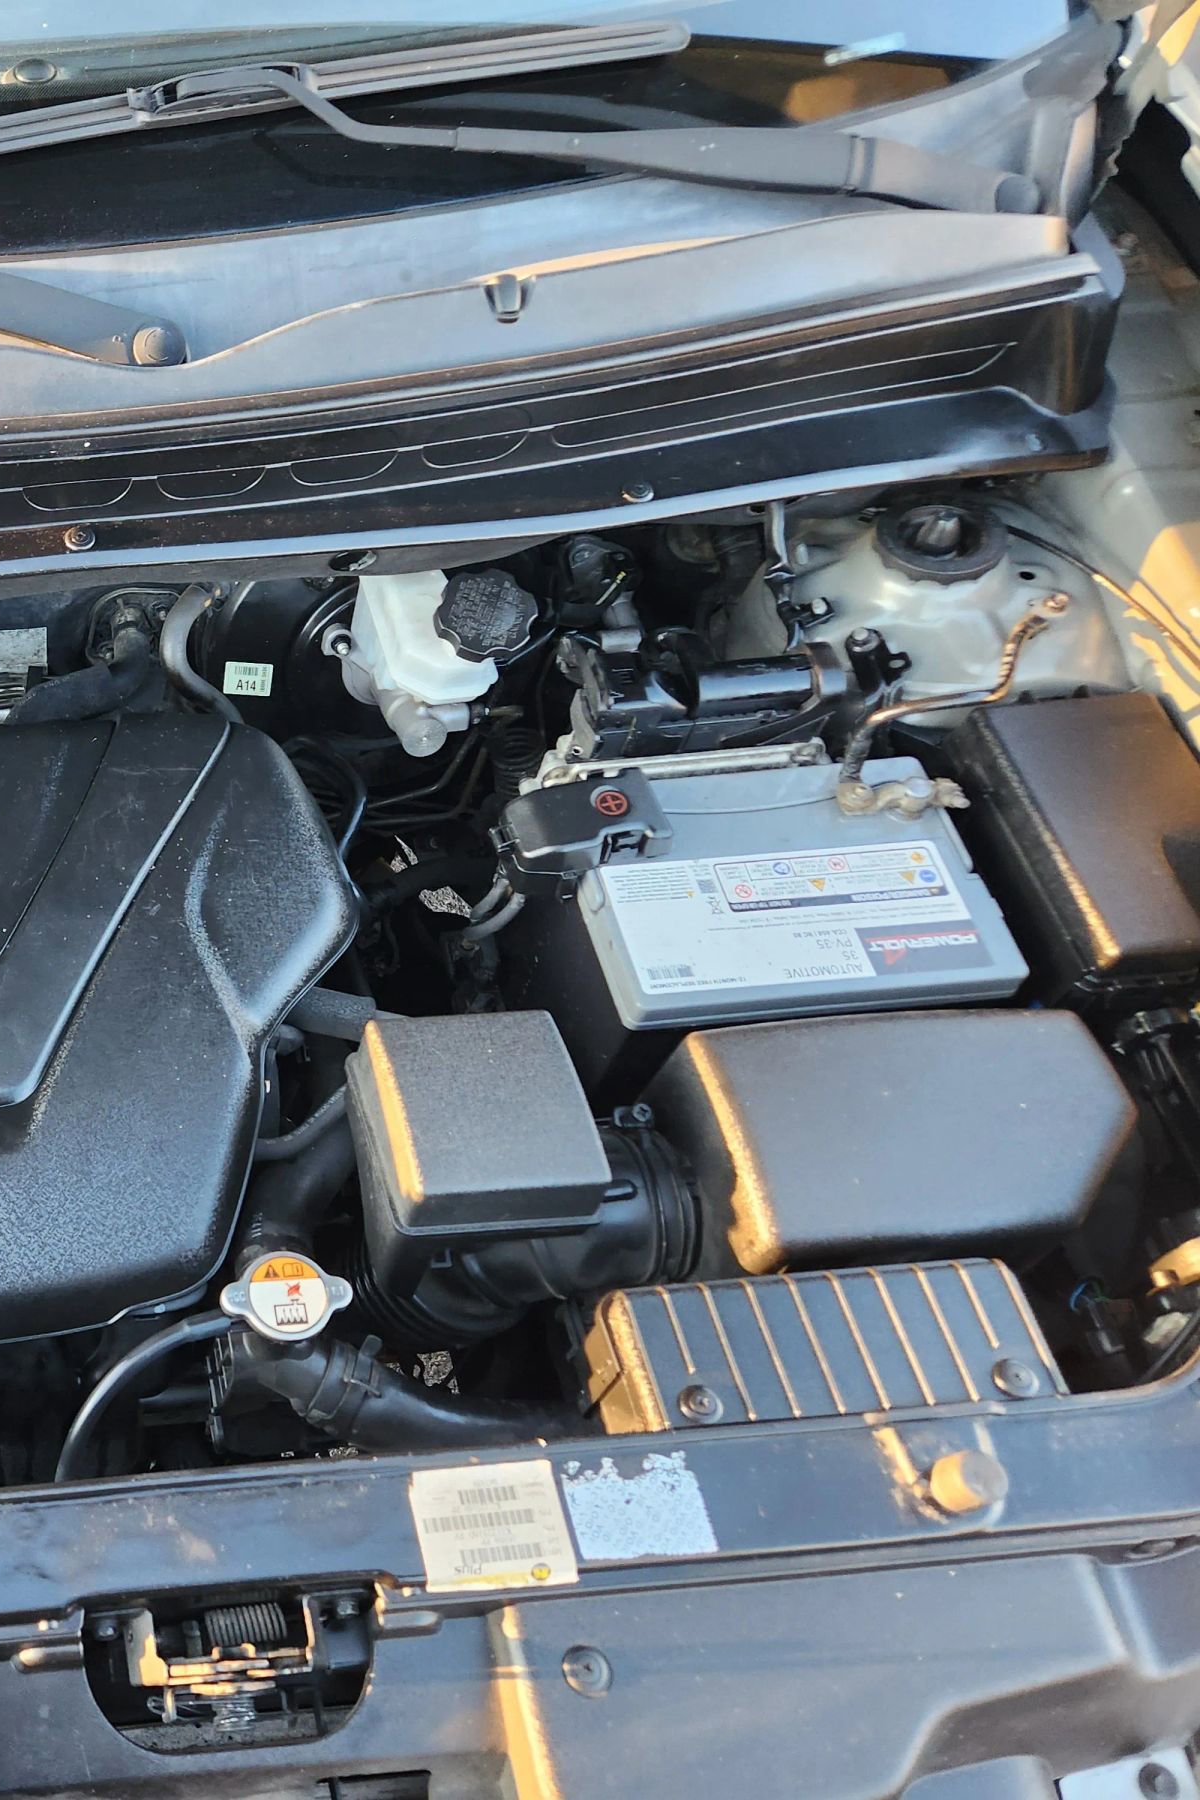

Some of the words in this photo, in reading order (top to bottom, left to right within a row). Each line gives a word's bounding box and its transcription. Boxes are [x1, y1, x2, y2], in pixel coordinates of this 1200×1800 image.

[235, 679, 257, 691] A14
[816, 937, 853, 949] PV-35
[868, 934, 978, 952] POWERVOLT
[841, 950, 860, 960] 35
[783, 962, 864, 979] AUTOMOTIVE
